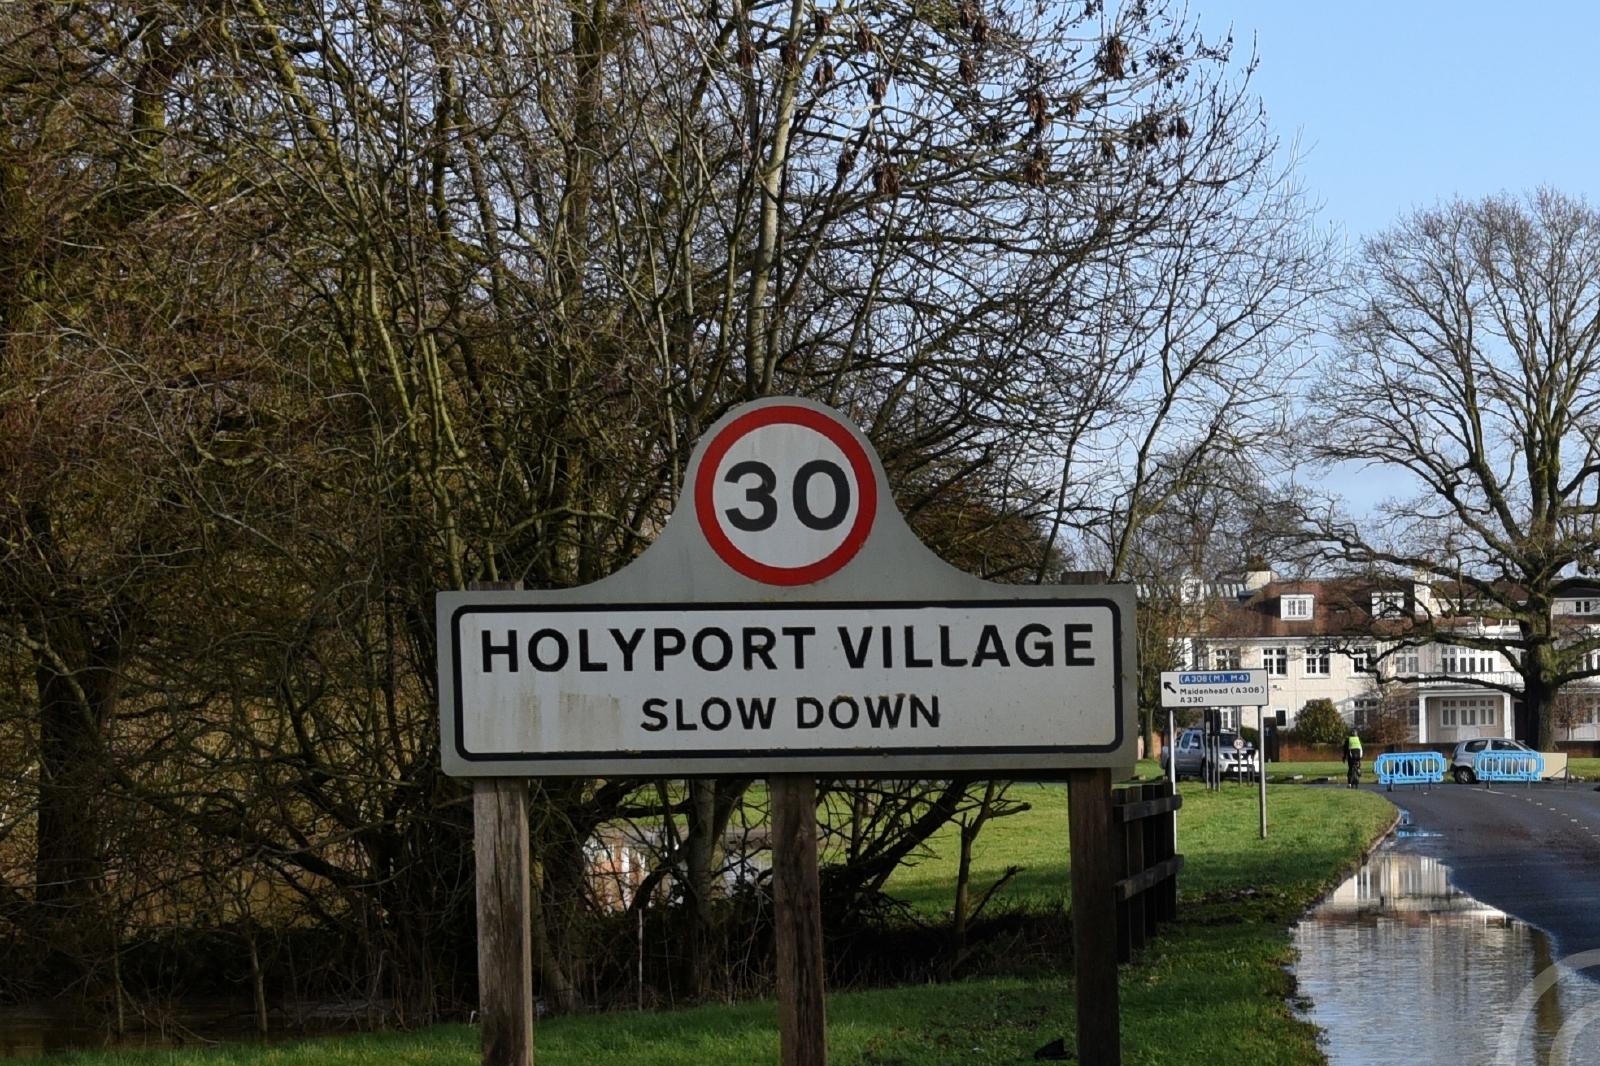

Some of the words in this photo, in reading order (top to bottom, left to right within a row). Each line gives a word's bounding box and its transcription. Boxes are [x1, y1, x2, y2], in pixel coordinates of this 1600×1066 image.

[724, 459, 851, 533] 30
[480, 626, 816, 673] HOLYPORT
[838, 623, 1096, 669] VILLAGE
[640, 696, 776, 732] SLOW
[796, 693, 941, 730] DOWN
[1180, 687, 1228, 695] Maidenhead
[1231, 686, 1265, 694] (A308)
